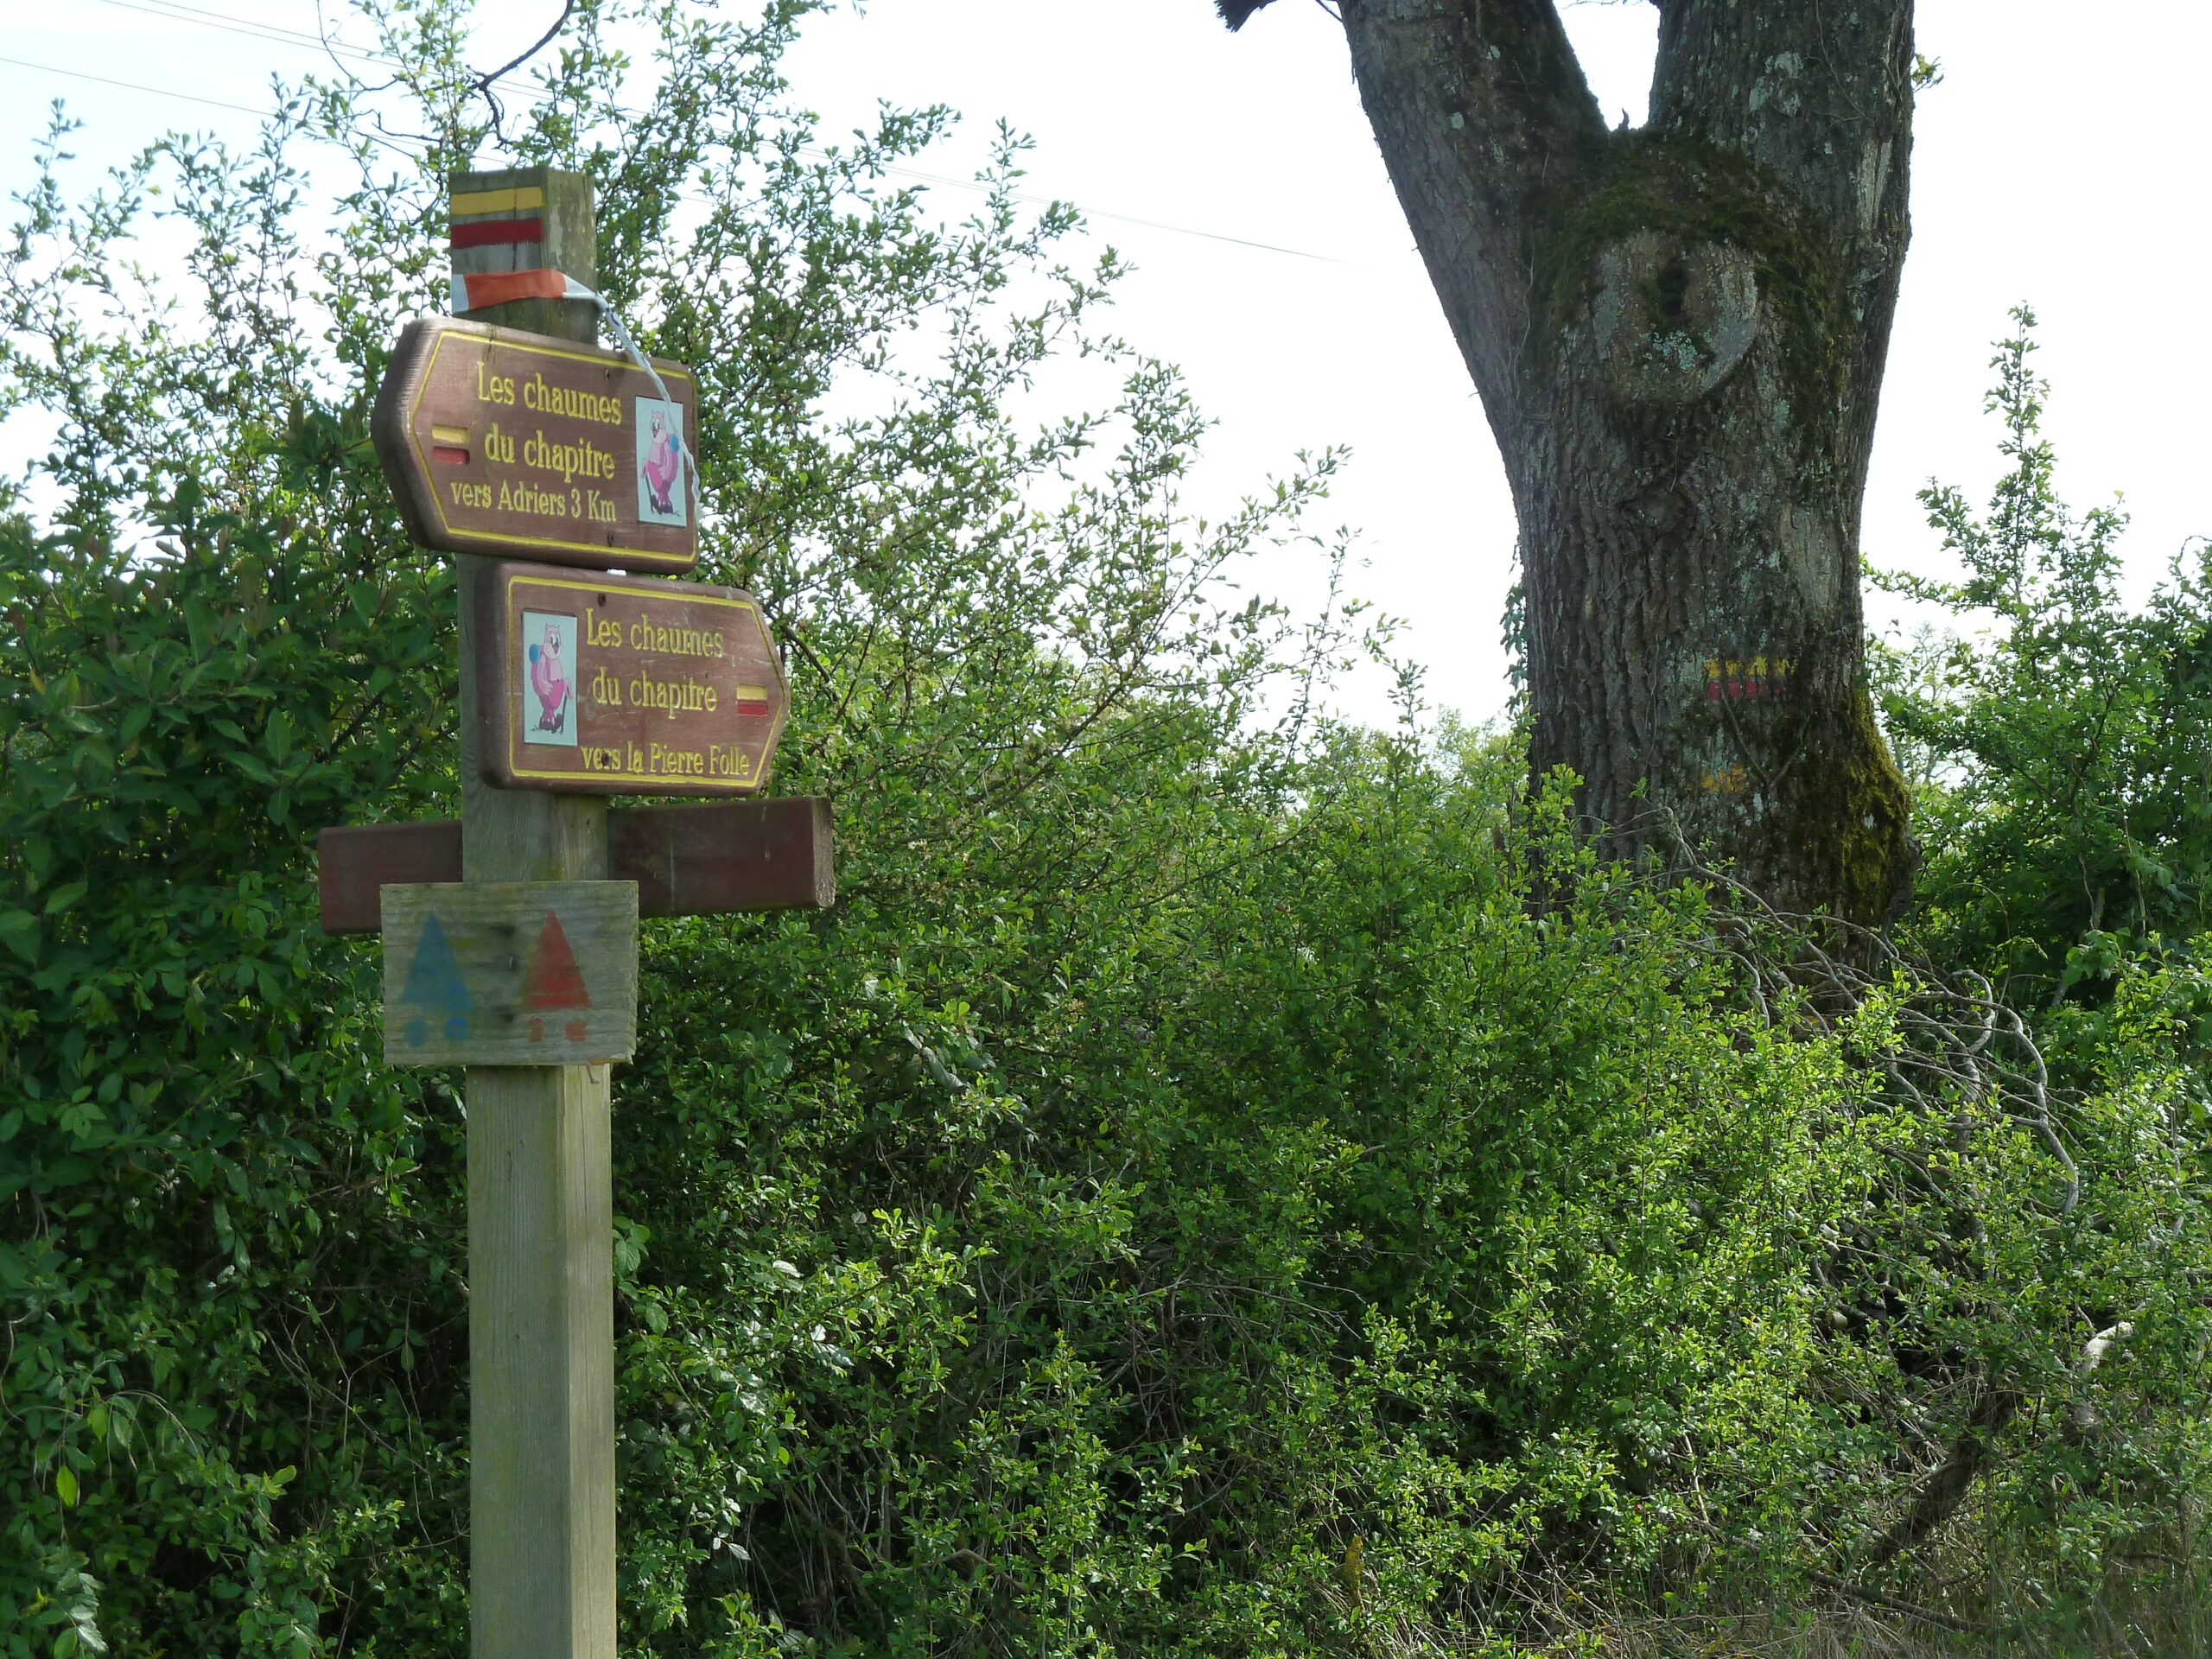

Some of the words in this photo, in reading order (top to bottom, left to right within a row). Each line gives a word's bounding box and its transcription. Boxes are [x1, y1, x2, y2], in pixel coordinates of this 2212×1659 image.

[477, 361, 514, 405] Les
[524, 372, 622, 425] chaumes
[484, 422, 516, 464] du
[524, 429, 615, 483] chapitre
[450, 481, 492, 509] vers
[498, 480, 565, 518] Adriers
[571, 486, 582, 518] 3
[588, 490, 616, 522] Km
[586, 607, 622, 647] Les
[630, 614, 724, 658] chaumes
[592, 666, 622, 705] du
[630, 671, 718, 719] chapitre
[626, 740, 644, 774] la
[650, 741, 703, 774] Pierre
[709, 744, 750, 776] Folle
